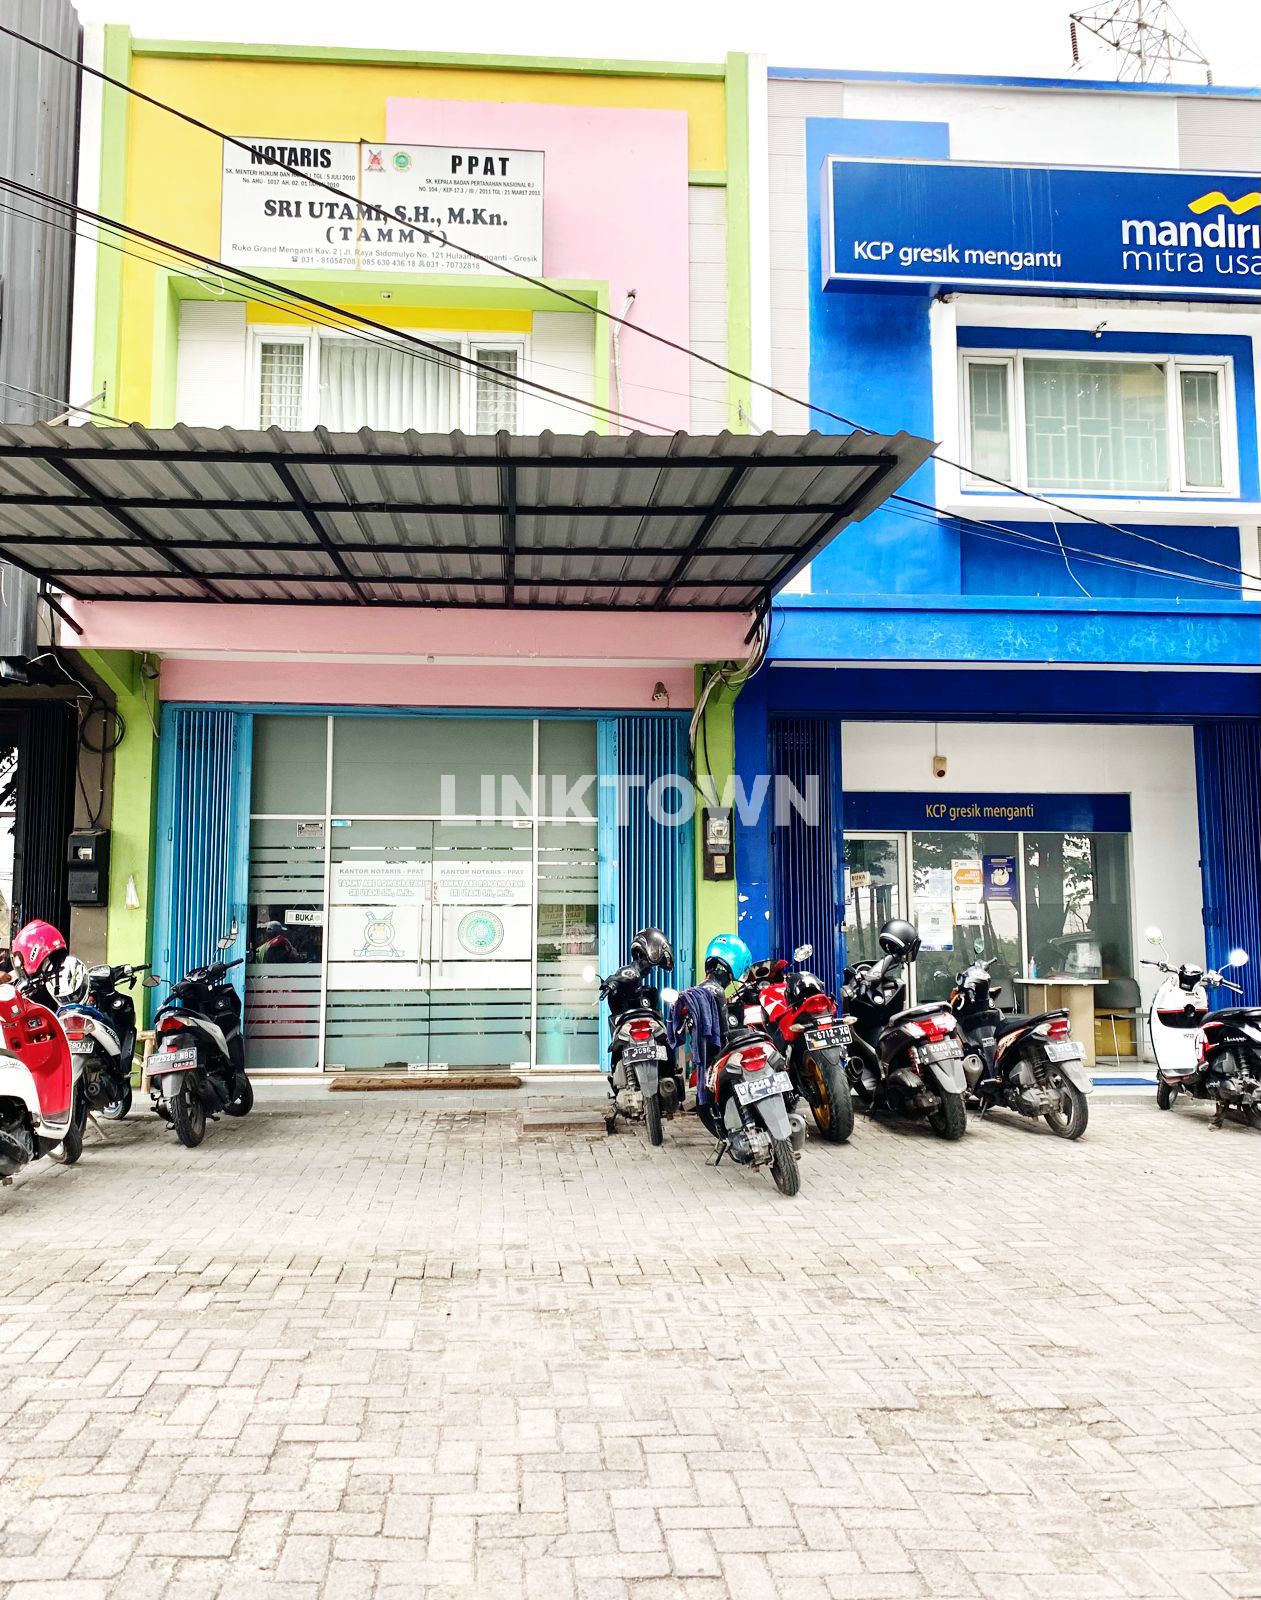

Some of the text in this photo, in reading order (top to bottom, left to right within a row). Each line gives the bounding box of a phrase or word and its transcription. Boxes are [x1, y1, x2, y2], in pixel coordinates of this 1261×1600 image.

[250, 145, 332, 169] NOTARIS
[451, 155, 510, 176] PPAT
[264, 199, 302, 218] SRI
[394, 205, 442, 227] S.H.,
[448, 207, 508, 226] M.Kn.
[1121, 213, 1260, 249] mandiri
[231, 244, 252, 252] Ruko
[253, 245, 277, 253] Grand
[279, 246, 313, 255] Menganti
[355, 249, 373, 257] Raya
[375, 249, 415, 259] Sidomulyo
[514, 254, 538, 263] Gresik
[854, 240, 1062, 271] KCP gresik menganti
[1123, 249, 1204, 273] mitra
[925, 803, 1034, 821] KCP gresik menganti
[295, 913, 314, 922] BUKA
